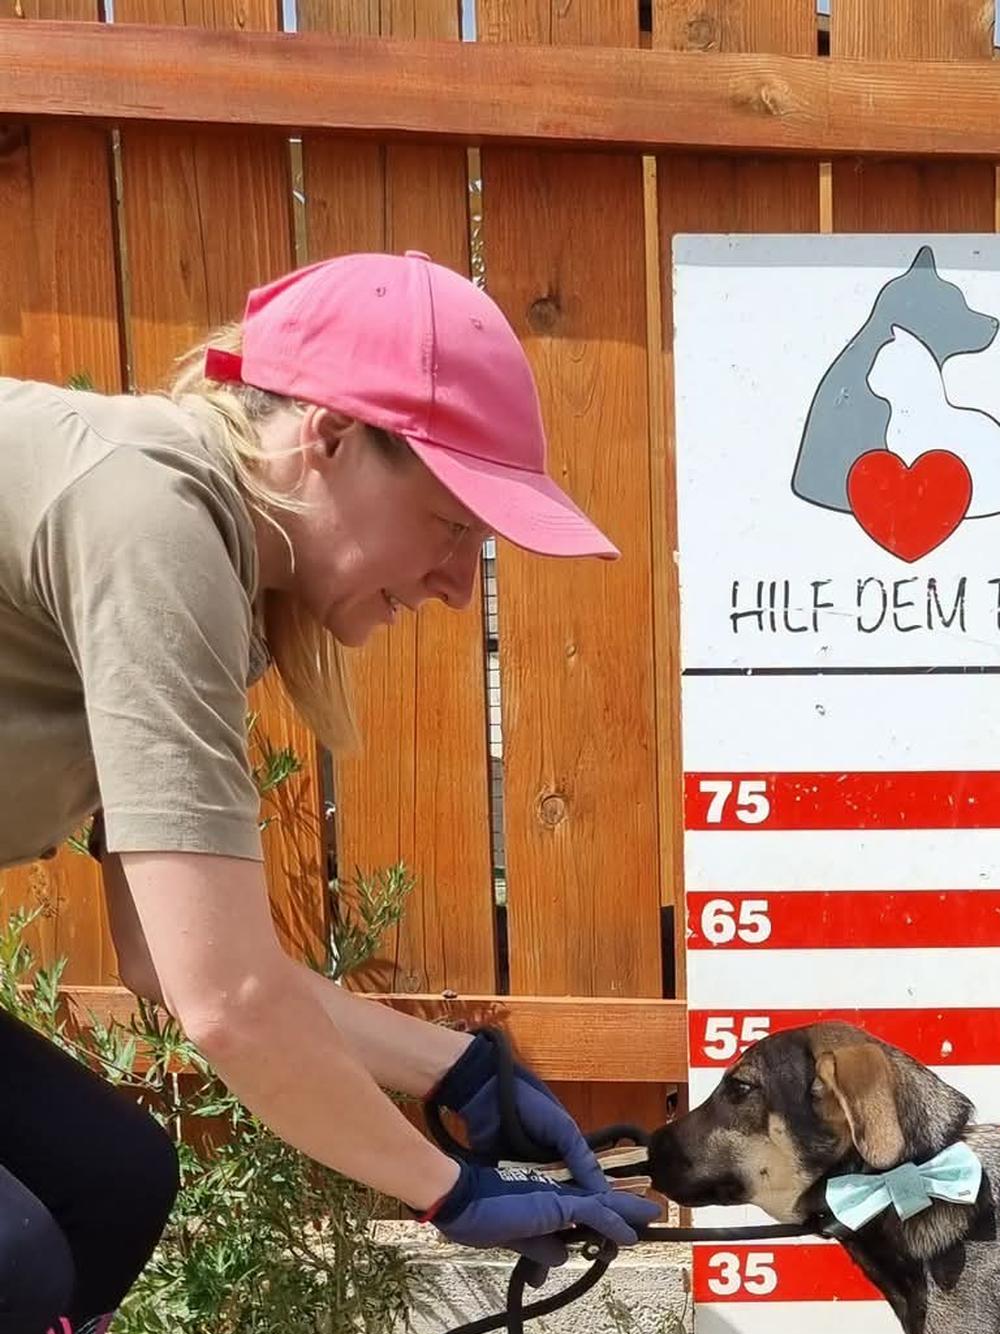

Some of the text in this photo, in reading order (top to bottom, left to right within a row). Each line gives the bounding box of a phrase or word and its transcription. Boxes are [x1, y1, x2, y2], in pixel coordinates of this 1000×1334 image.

[729, 579, 834, 634] HILF
[856, 576, 967, 633] DEM
[699, 780, 771, 824] 75
[700, 899, 773, 944] 65
[707, 1252, 778, 1295] 35
